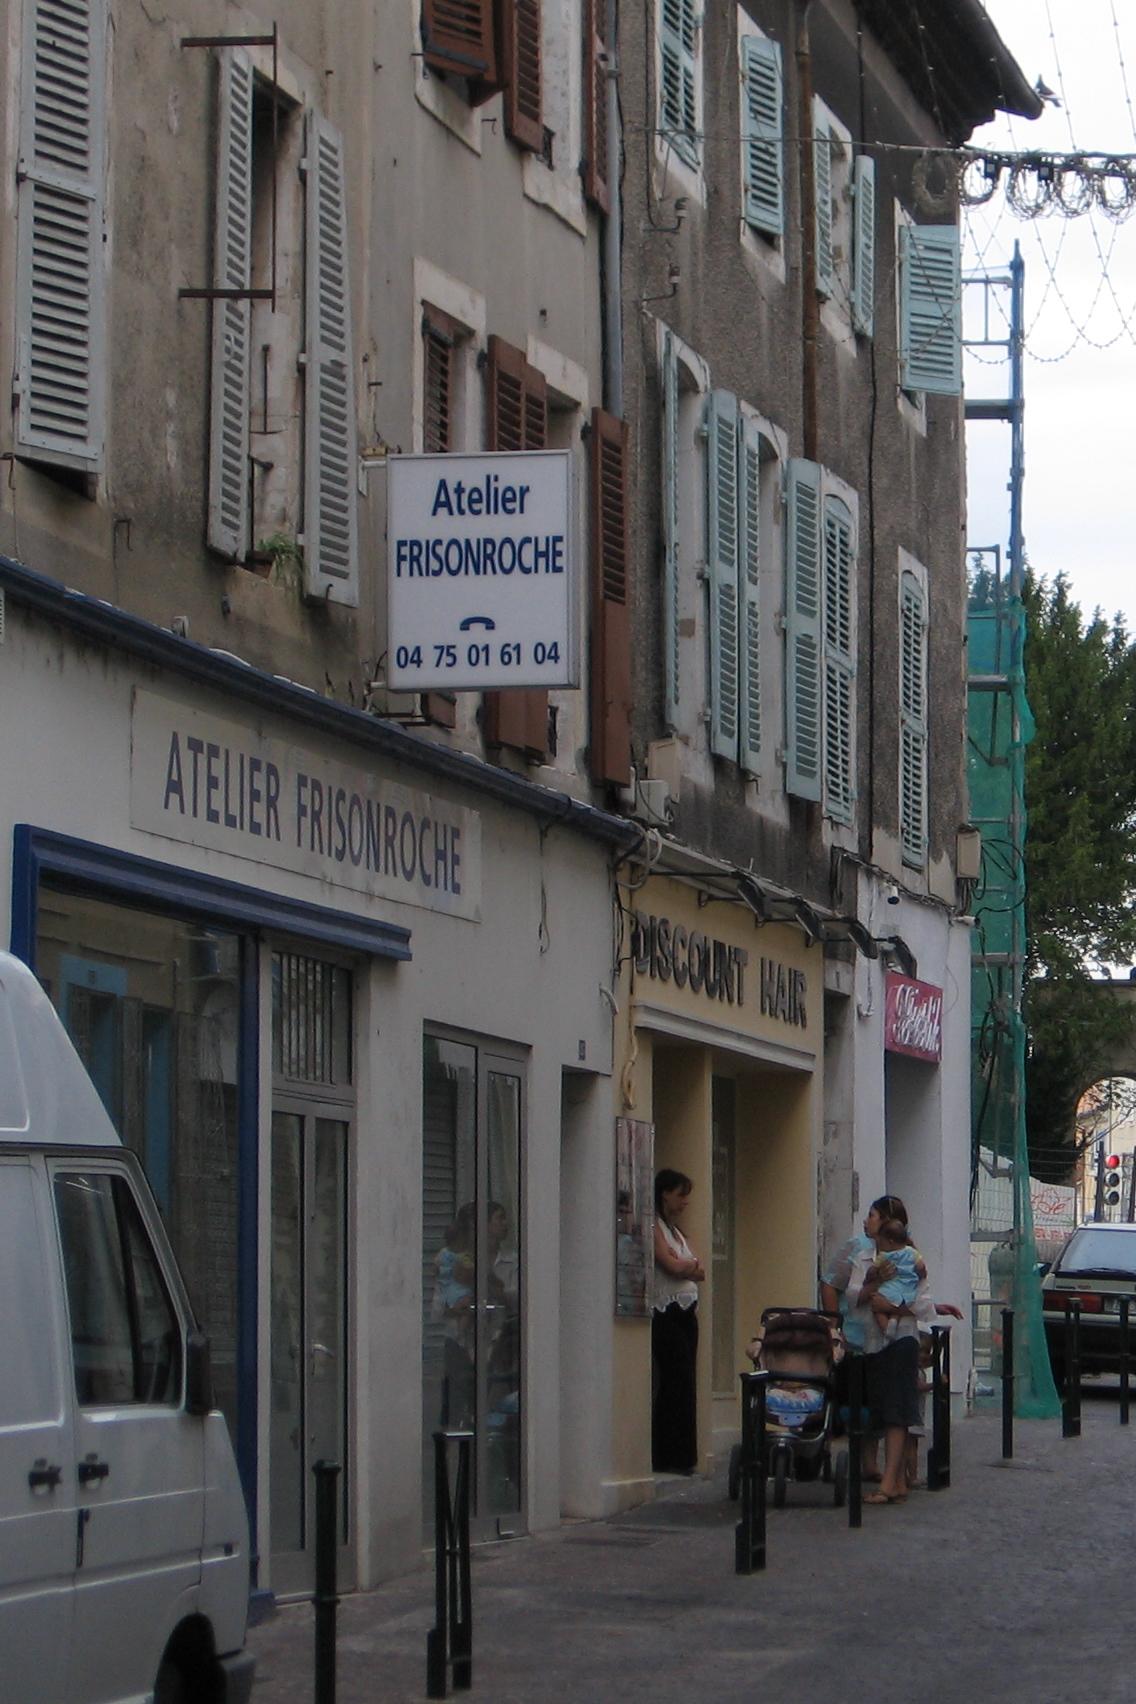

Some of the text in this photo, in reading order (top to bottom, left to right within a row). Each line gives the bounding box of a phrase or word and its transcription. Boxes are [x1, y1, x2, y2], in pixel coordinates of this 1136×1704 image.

[432, 474, 530, 516] Atelier
[396, 535, 563, 577] FRISONROCHE
[396, 641, 560, 669] 04 75 01 61 04
[164, 731, 461, 895] ATELIER FRISONROCHE
[635, 911, 748, 1007] DISCOUNT
[760, 957, 807, 1029] HAIR
